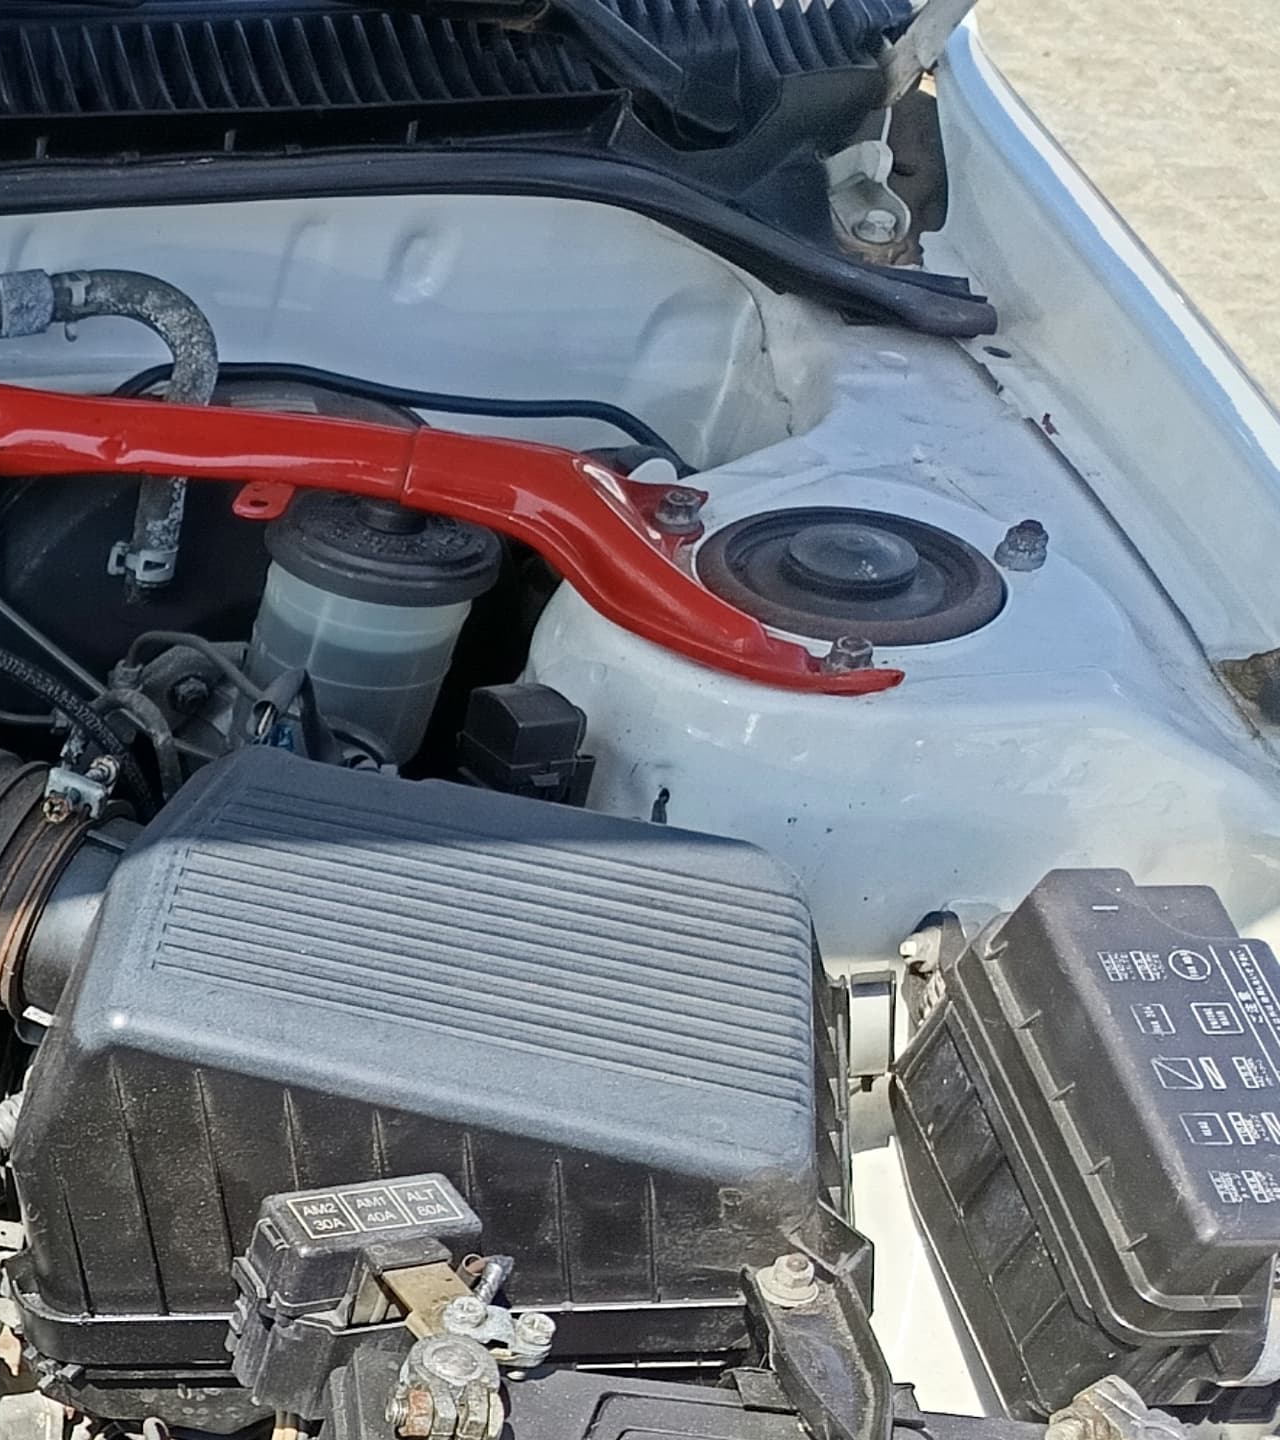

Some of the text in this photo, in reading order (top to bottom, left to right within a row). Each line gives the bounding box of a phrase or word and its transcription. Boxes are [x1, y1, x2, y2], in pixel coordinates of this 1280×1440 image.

[407, 1189, 435, 1202] ALT
[303, 1203, 338, 1216] AM2
[356, 1197, 387, 1209] AM1
[367, 1211, 397, 1223] 40A
[313, 1217, 346, 1231] 30A
